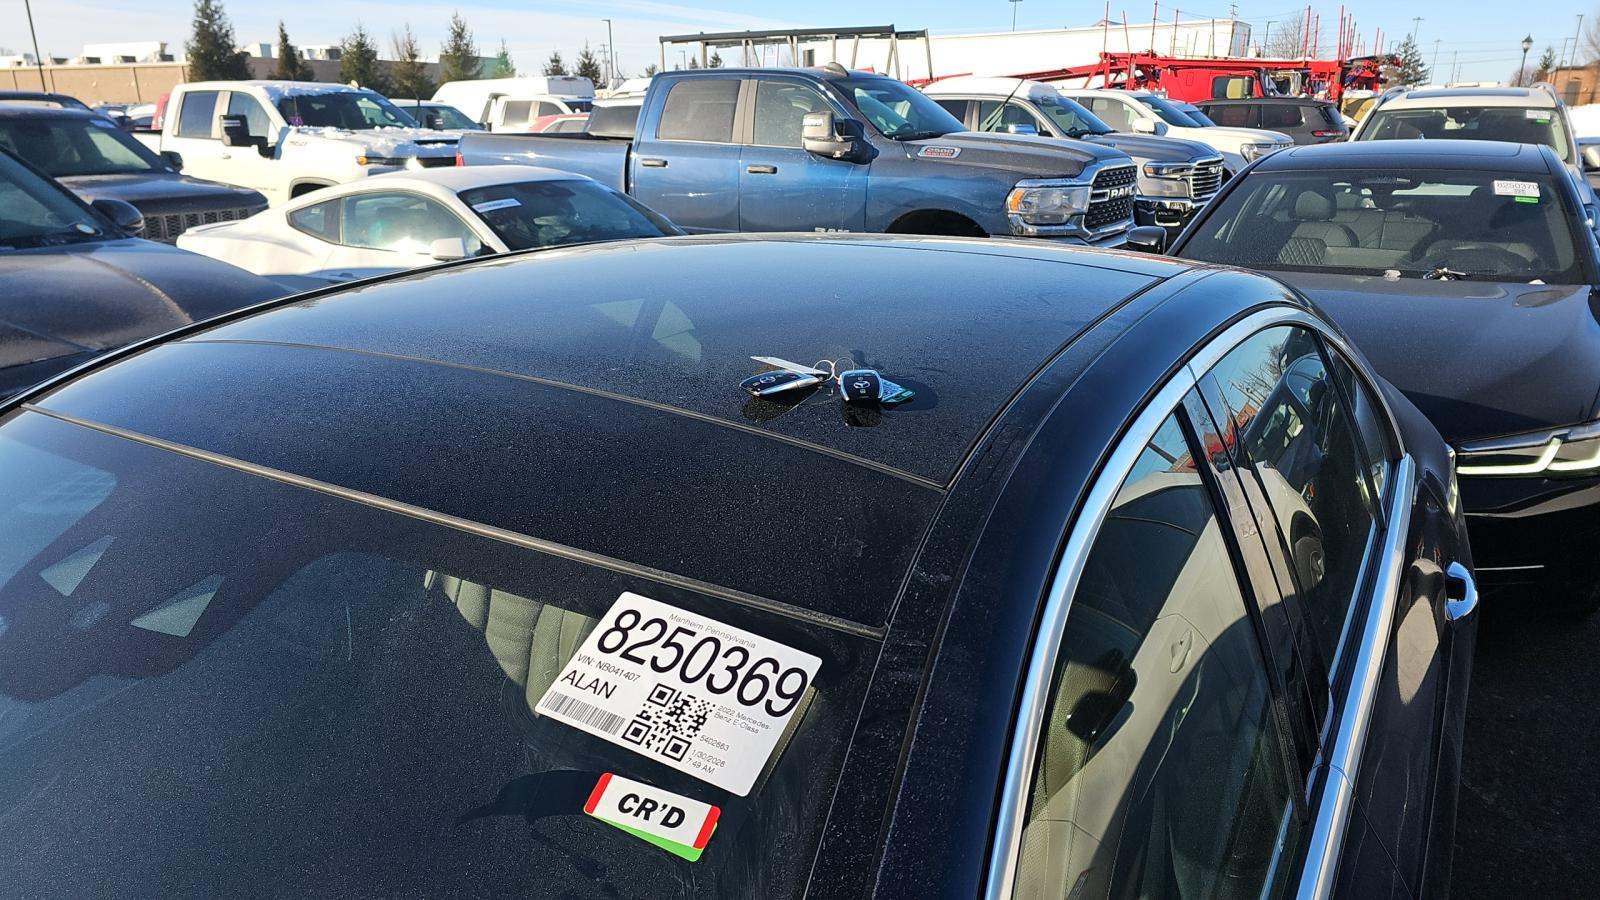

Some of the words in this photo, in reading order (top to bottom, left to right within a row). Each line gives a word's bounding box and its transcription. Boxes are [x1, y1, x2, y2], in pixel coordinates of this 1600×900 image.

[1111, 186, 1135, 199] RAM
[669, 612, 704, 630] Manheim
[705, 624, 757, 649] Pennsylvania
[577, 653, 595, 667] VIN:
[596, 660, 641, 682] NB041407
[597, 608, 808, 718] 8250369
[560, 669, 617, 699] ALAN
[713, 712, 732, 724] Benz
[732, 719, 760, 734] E-Class
[717, 705, 736, 716] 2022
[736, 712, 771, 730] Mercedes-
[702, 765, 716, 775] AM
[617, 793, 686, 830] CR'D
